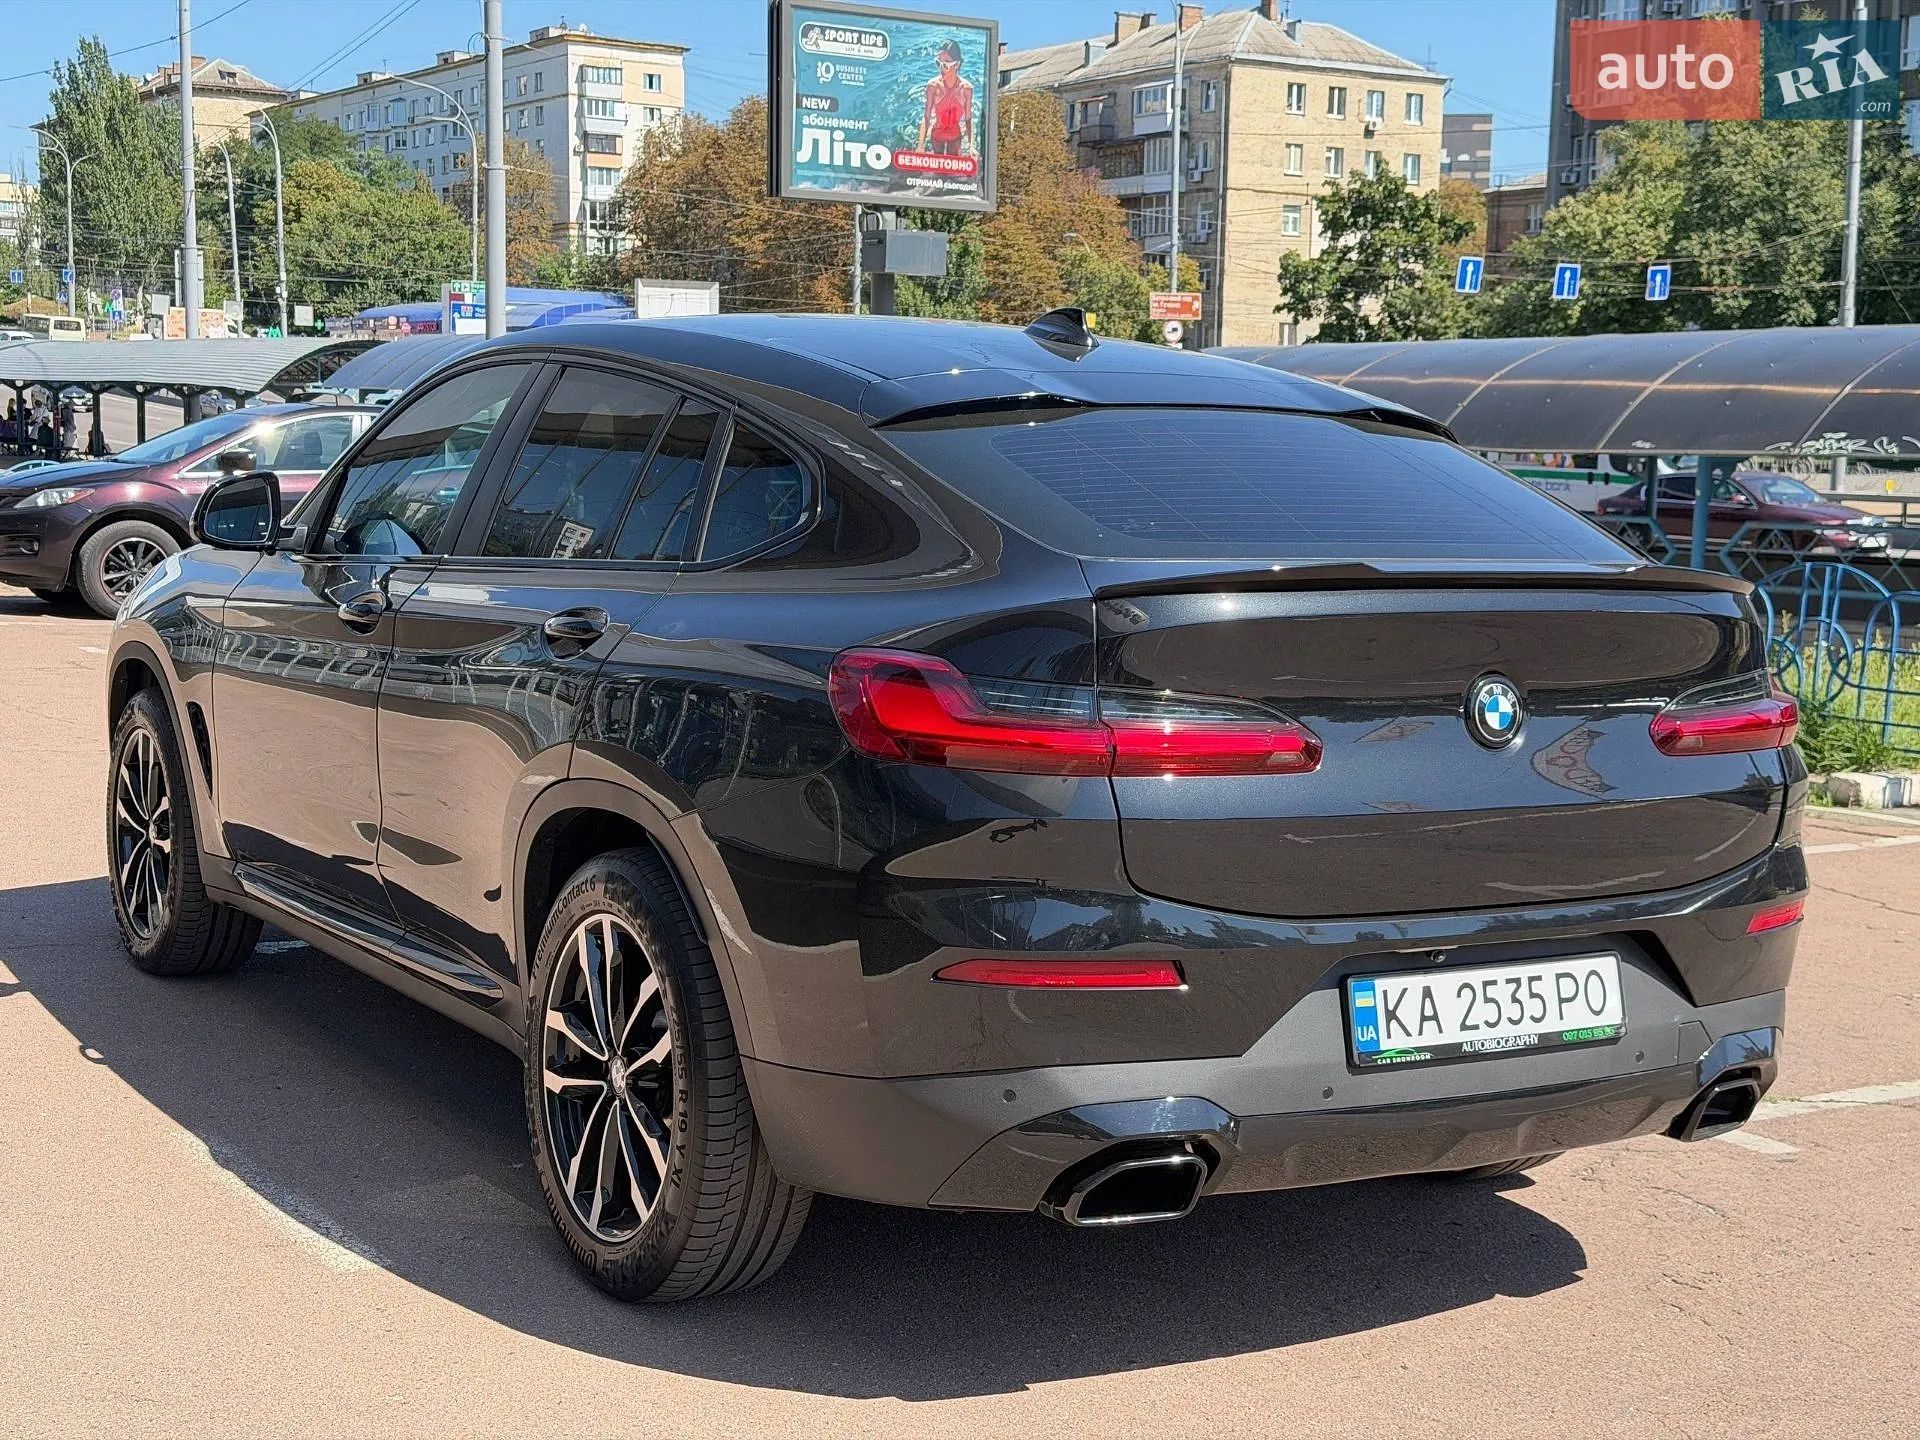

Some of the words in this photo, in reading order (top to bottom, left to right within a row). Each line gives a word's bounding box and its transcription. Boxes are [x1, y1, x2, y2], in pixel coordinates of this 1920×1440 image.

[825, 28, 859, 44] SPORT
[802, 96, 830, 110] NEW
[802, 114, 869, 130] абонемент
[796, 128, 892, 169] Літо
[898, 153, 973, 171] БЕЗКОШТОВНО
[906, 177, 943, 188] ОТРИМАЙ
[1480, 685, 1516, 704] BMW
[590, 875, 597, 892] 6
[1382, 985, 1444, 1040] KA
[1456, 974, 1548, 1032] 2535
[1357, 1025, 1377, 1042] UA
[1461, 1033, 1539, 1052] AUTOBIOGRAPHY
[1377, 1057, 1391, 1065] CAR
[1392, 1054, 1431, 1064] SHOWROOM
